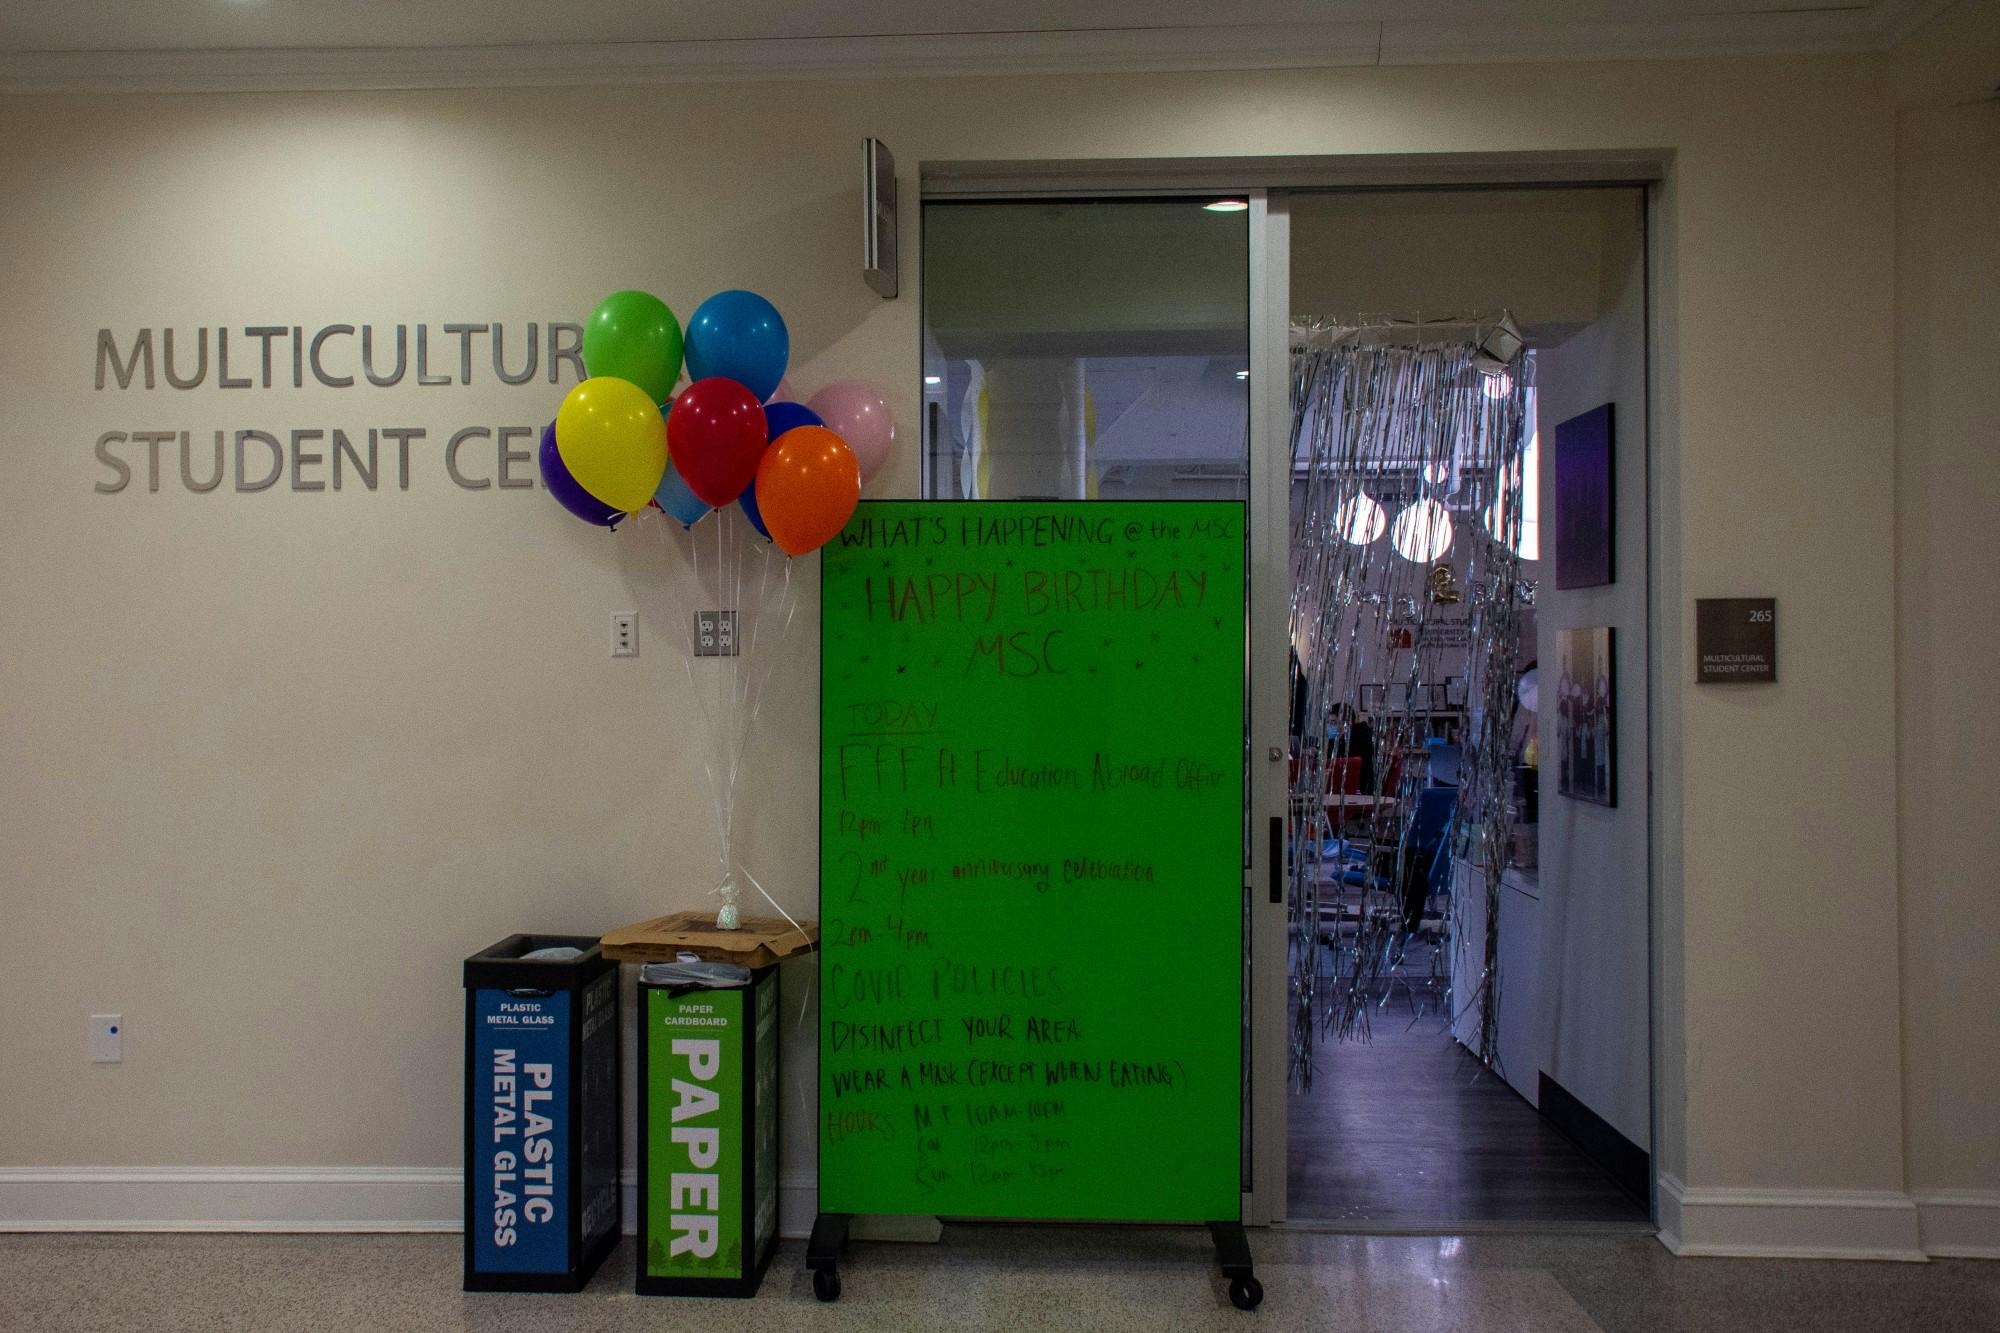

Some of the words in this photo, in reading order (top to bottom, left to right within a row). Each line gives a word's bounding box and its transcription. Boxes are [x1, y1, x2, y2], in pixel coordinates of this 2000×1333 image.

[94, 322, 588, 389] MULTICULTUR
[94, 428, 426, 495] STUDENT
[444, 426, 546, 491] CE
[841, 516, 948, 549] WHAT'S
[960, 516, 1114, 547] HAPPENING
[1123, 521, 1144, 542] @
[1150, 519, 1182, 541] the
[1189, 517, 1237, 541] MSC
[864, 570, 999, 625] HAPPY
[1024, 568, 1208, 617] BIRTHDAY
[1749, 610, 1772, 622] 265
[963, 630, 1070, 679] MSC
[1703, 654, 1766, 663] MULTICULTURAL
[1703, 664, 1740, 673] STUDENT
[1741, 664, 1769, 673] CENTER
[845, 700, 940, 729] TODAY
[932, 956, 1065, 1006] POLICIES
[487, 1015, 519, 1025] METAL
[522, 1015, 555, 1025] GLASS
[499, 1003, 542, 1012] PLASTIC
[664, 1017, 728, 1026] CARDBOARD
[678, 1004, 714, 1014] PAPER
[831, 1017, 945, 1054] DISINFECT
[960, 1014, 1016, 1043] YOUR
[1025, 1015, 1082, 1044] AREA
[493, 1048, 516, 1144] METAL
[831, 1069, 892, 1098] WEAR
[900, 1072, 914, 1093] A
[918, 1060, 961, 1088] MASK
[1045, 1059, 1102, 1089] WHEN
[523, 1063, 554, 1224] PLASTIC
[670, 1038, 720, 1259] PAPER
[493, 1152, 517, 1247] GLASS
